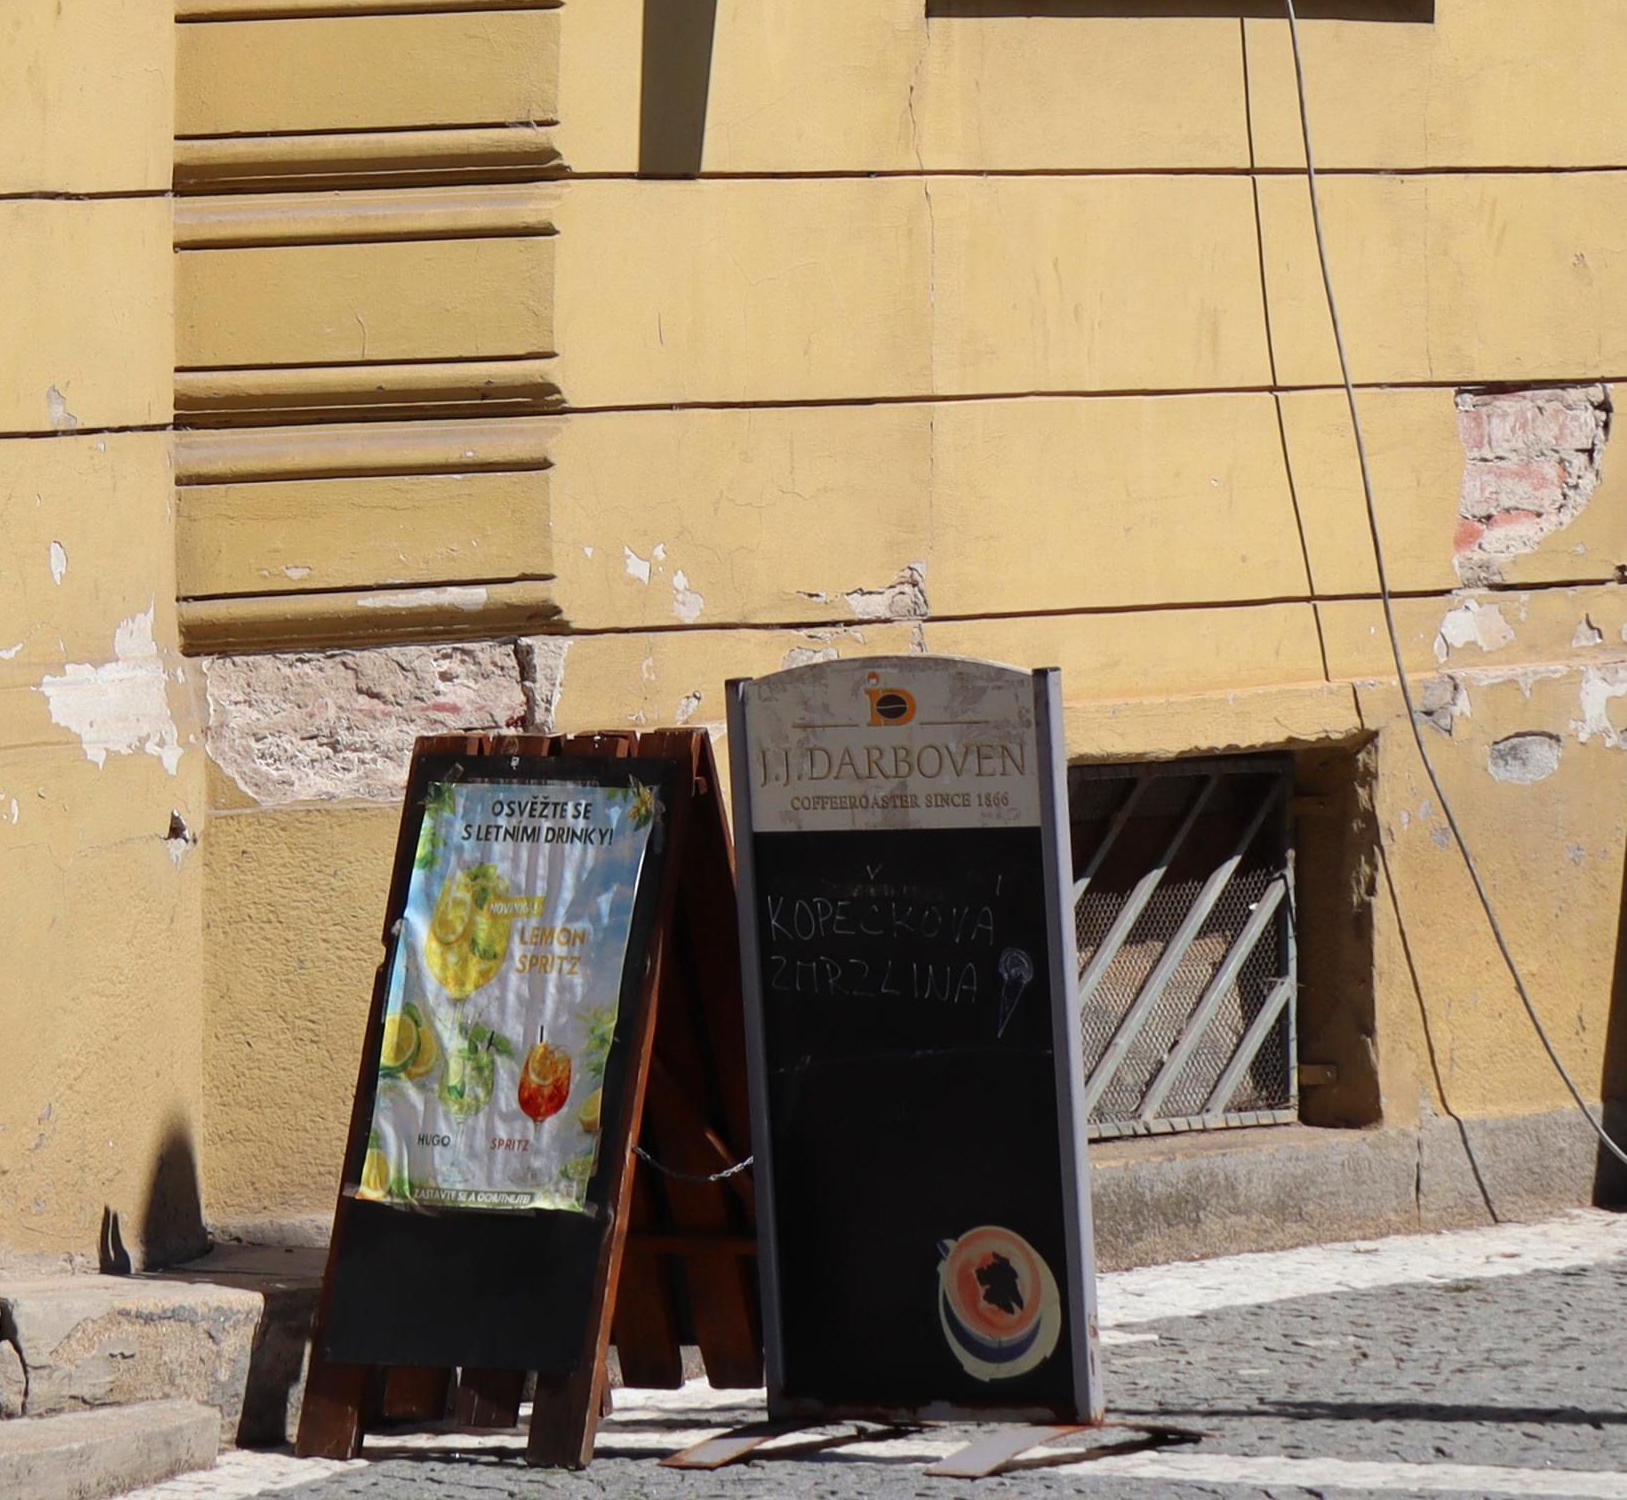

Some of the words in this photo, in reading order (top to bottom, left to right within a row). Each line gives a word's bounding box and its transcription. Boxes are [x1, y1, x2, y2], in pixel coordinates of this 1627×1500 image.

[491, 795, 569, 820] OSVĚŽTE
[571, 801, 593, 820] SE
[790, 793, 922, 811] COFFEEROASTER
[925, 792, 972, 809] SINCE
[976, 791, 1010, 807] 1866
[461, 823, 473, 842] S
[475, 820, 541, 845] LETNÍMI
[544, 826, 615, 846] DRINKY!
[517, 925, 587, 947] LEMON
[515, 953, 582, 976] SPRITZ
[770, 955, 979, 1004] ZMRZLINA
[417, 1133, 451, 1148] HUGO
[490, 1138, 531, 1152] SPRITZ
